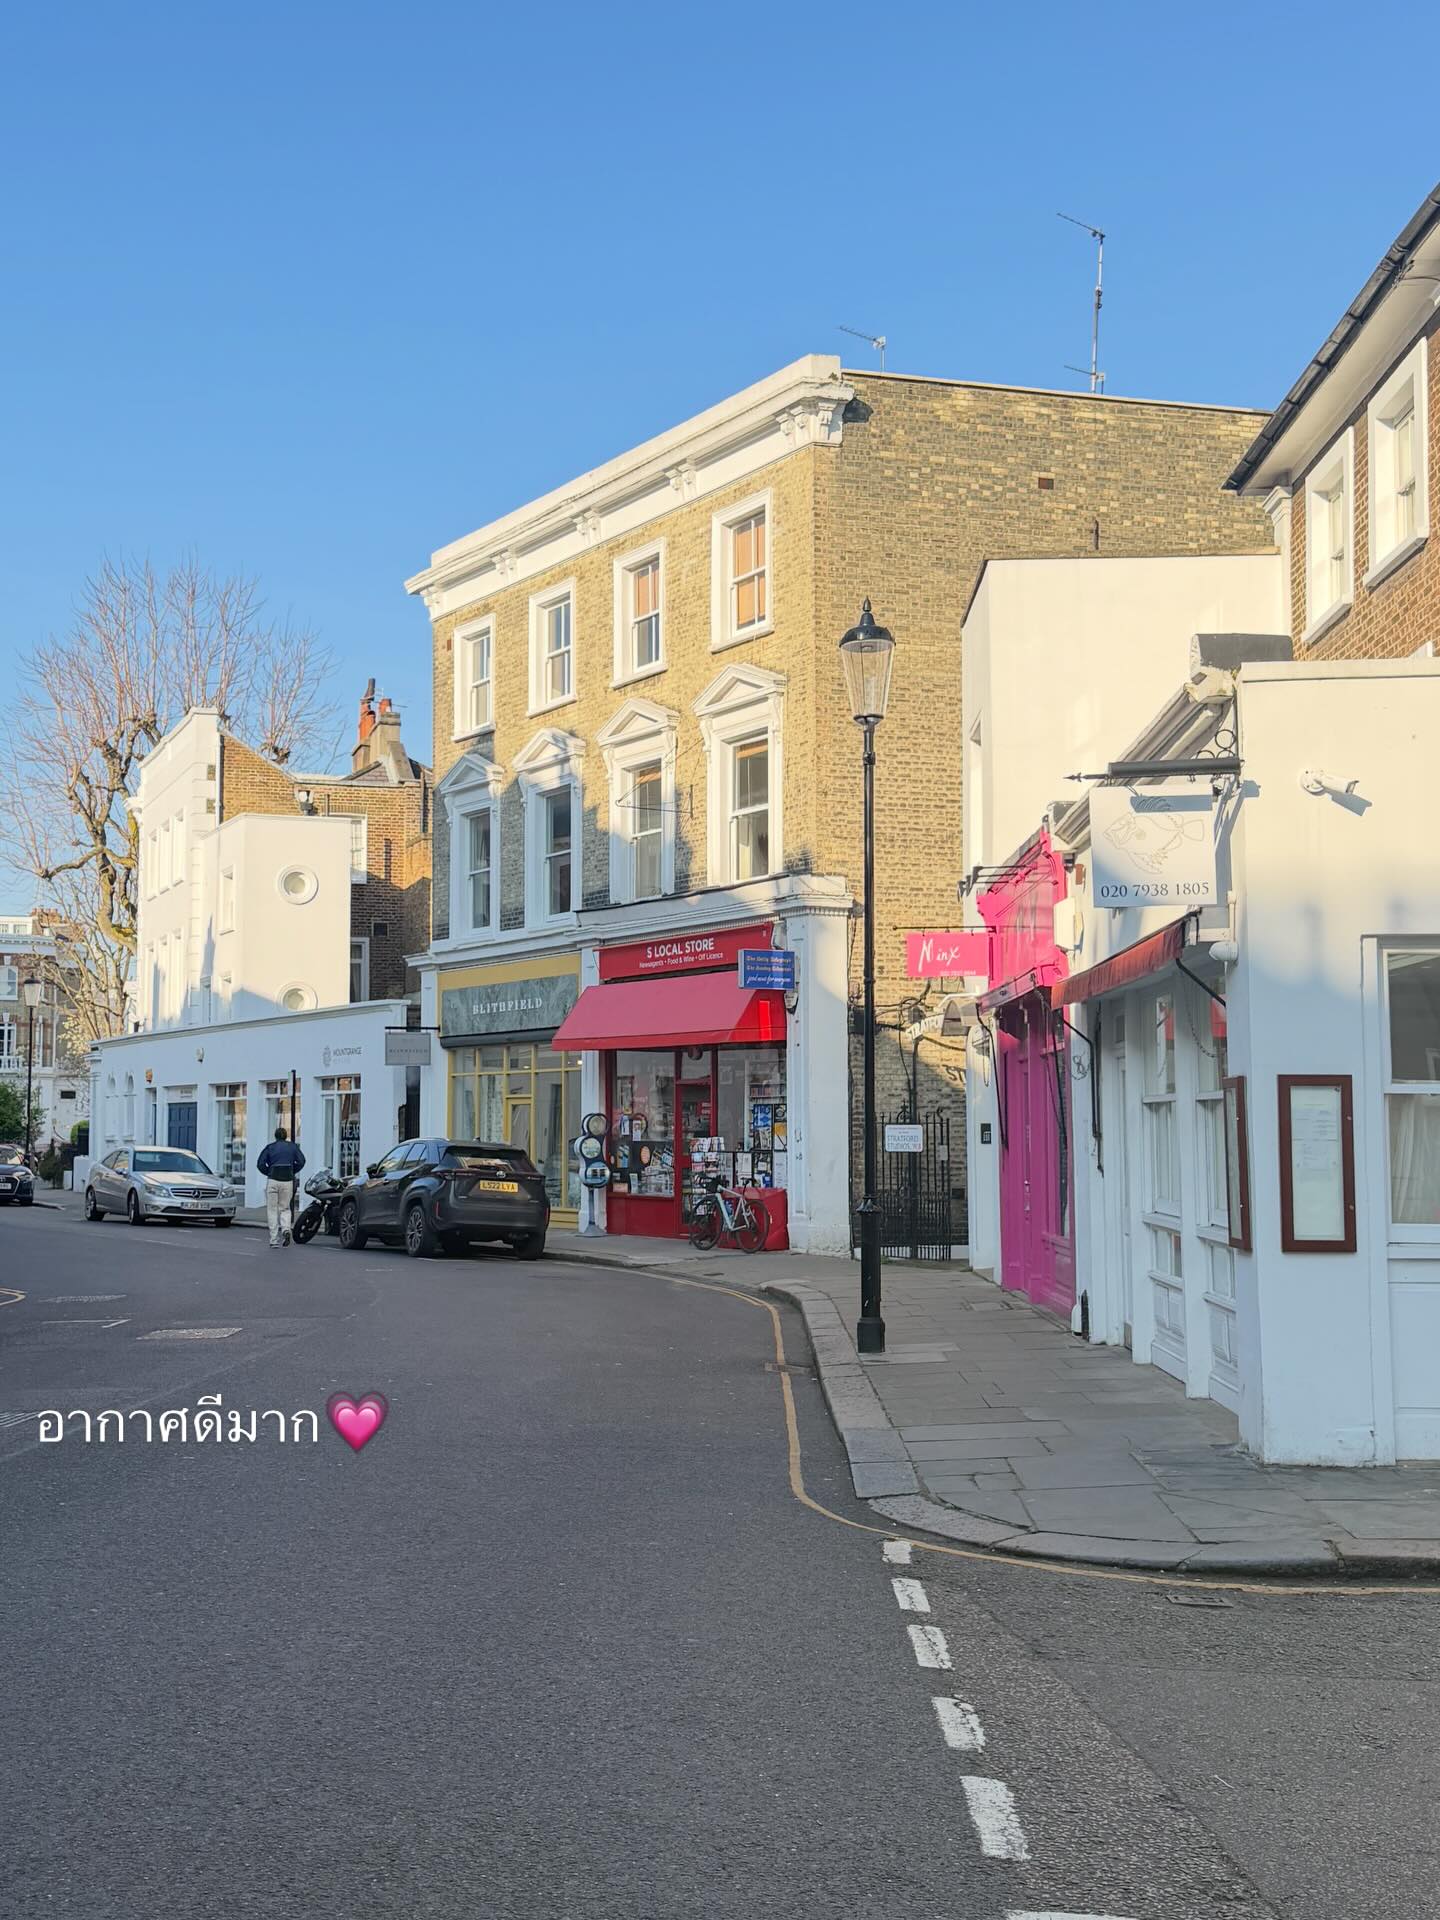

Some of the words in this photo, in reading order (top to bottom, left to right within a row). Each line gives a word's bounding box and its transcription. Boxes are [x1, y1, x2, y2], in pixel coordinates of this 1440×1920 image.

[1100, 884, 1128, 898] 020
[1132, 883, 1168, 897] 7938
[1176, 882, 1209, 896] 1805
[646, 946, 653, 960] S
[655, 943, 683, 958] LOCAL
[686, 937, 715, 954] STORE
[917, 938, 961, 974] Minx
[667, 957, 679, 967] Food
[684, 954, 696, 963] Wine
[473, 997, 543, 1015] BLITHFIELD
